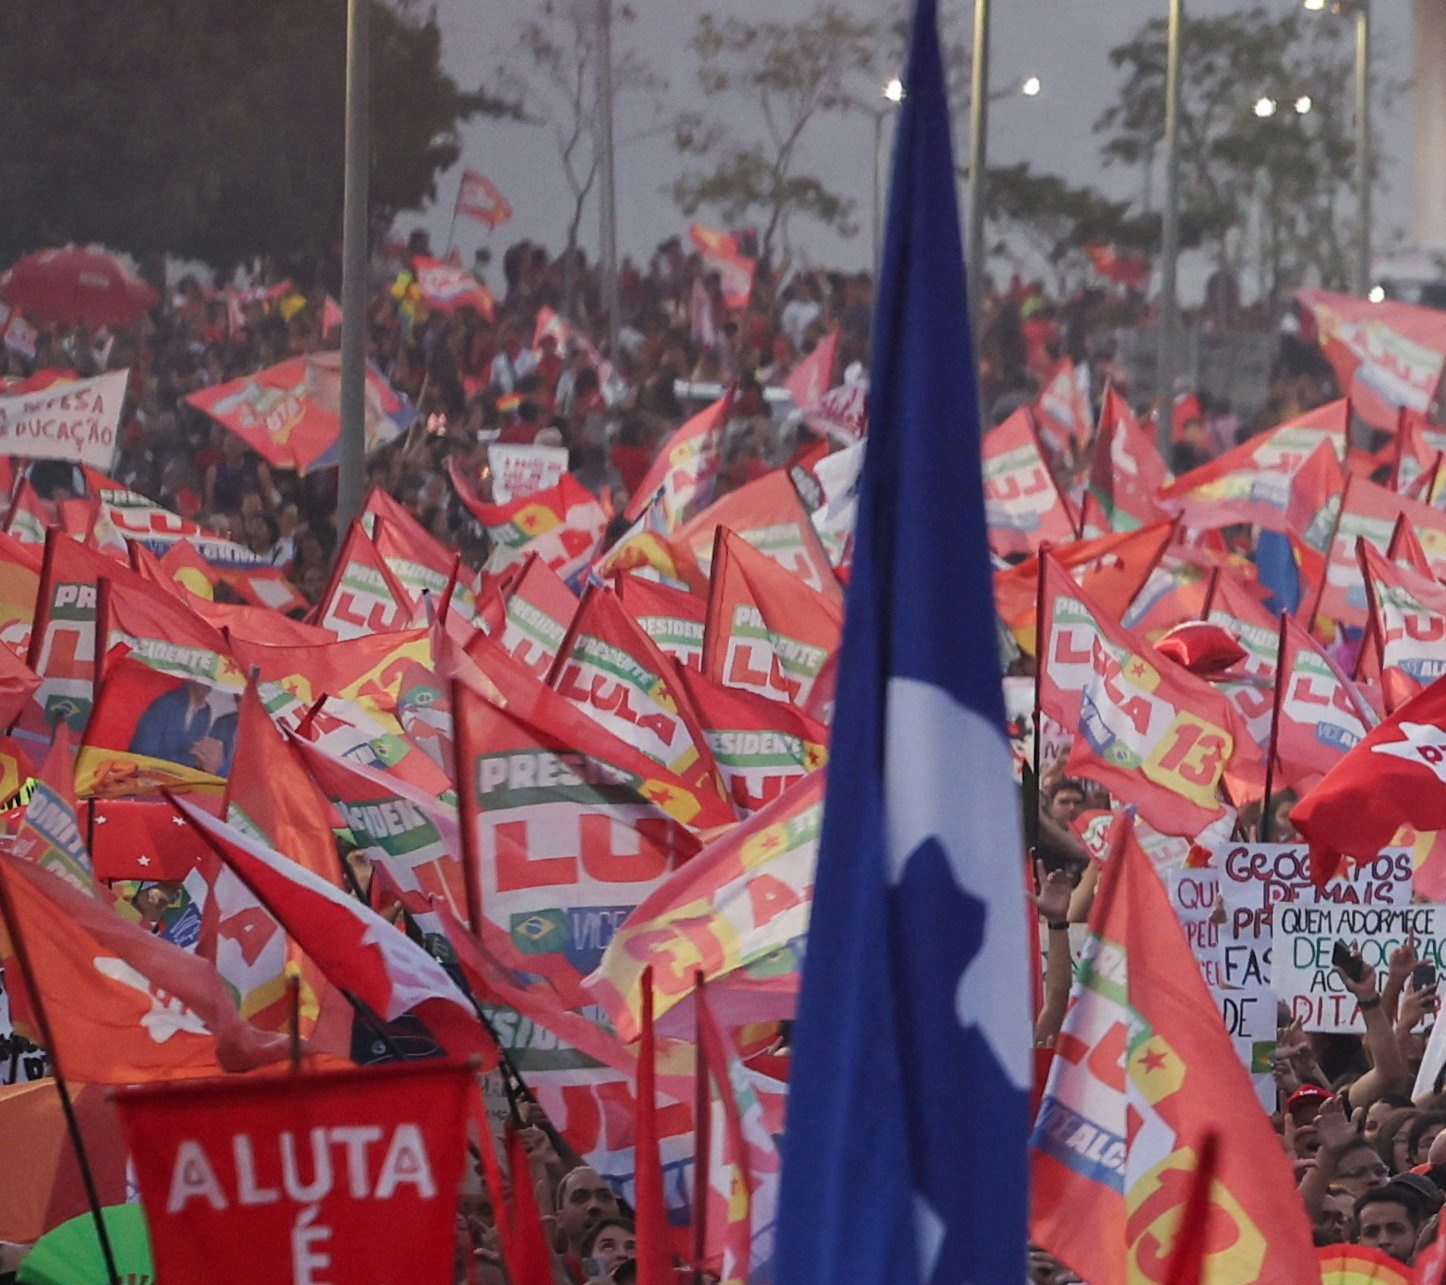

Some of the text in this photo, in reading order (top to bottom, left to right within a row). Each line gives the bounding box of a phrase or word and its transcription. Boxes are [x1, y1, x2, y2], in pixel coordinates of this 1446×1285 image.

[558, 662, 677, 747] LULA
[1157, 720, 1225, 789] 13
[494, 812, 668, 894] LU
[1281, 908, 1333, 935] QUEM
[1336, 907, 1436, 935] ADORMECE
